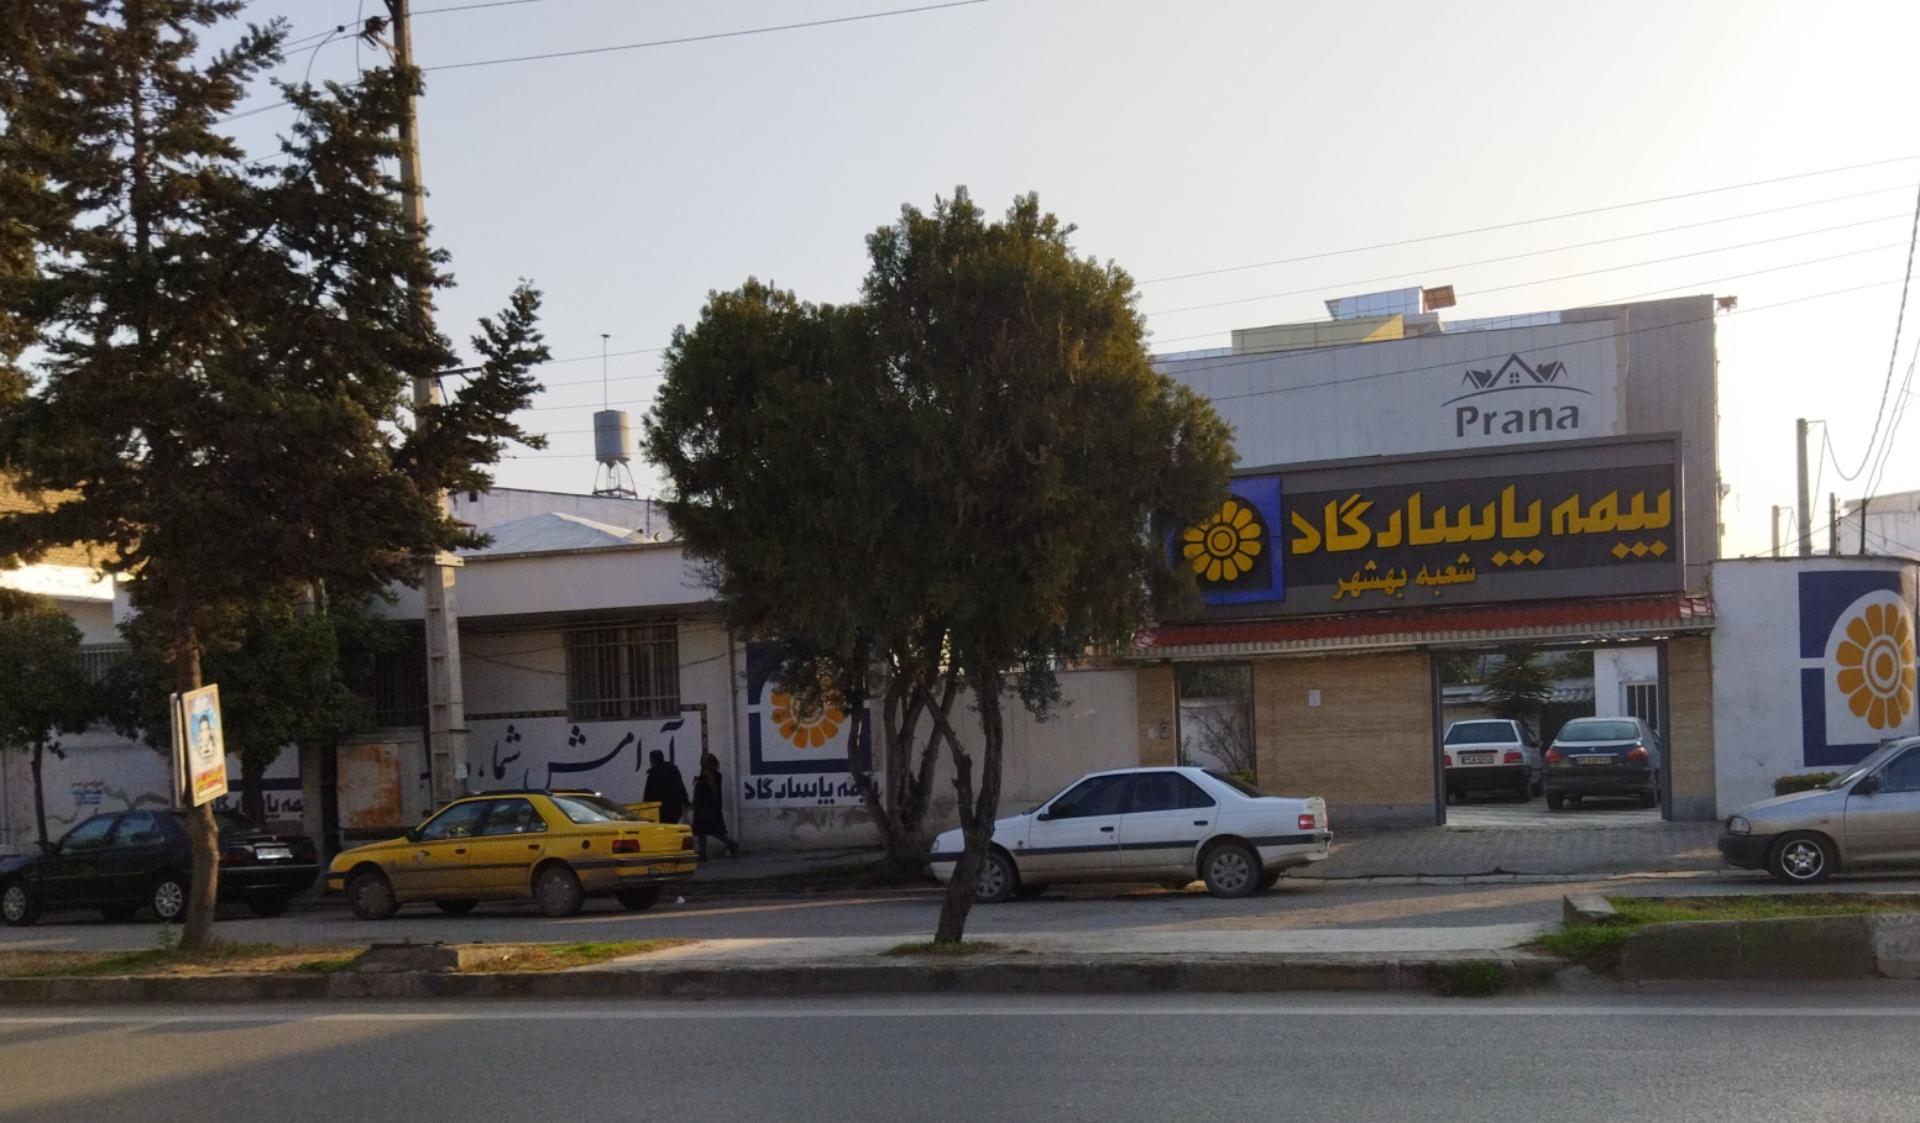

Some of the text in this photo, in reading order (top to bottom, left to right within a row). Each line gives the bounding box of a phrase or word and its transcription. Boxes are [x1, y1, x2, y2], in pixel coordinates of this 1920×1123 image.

[1456, 406, 1579, 437] Prana
[1291, 483, 1672, 568] بیمه پاسارگاد
[1331, 552, 1476, 600] شعبه بهشهر
[743, 775, 835, 805] پاسارگاد
